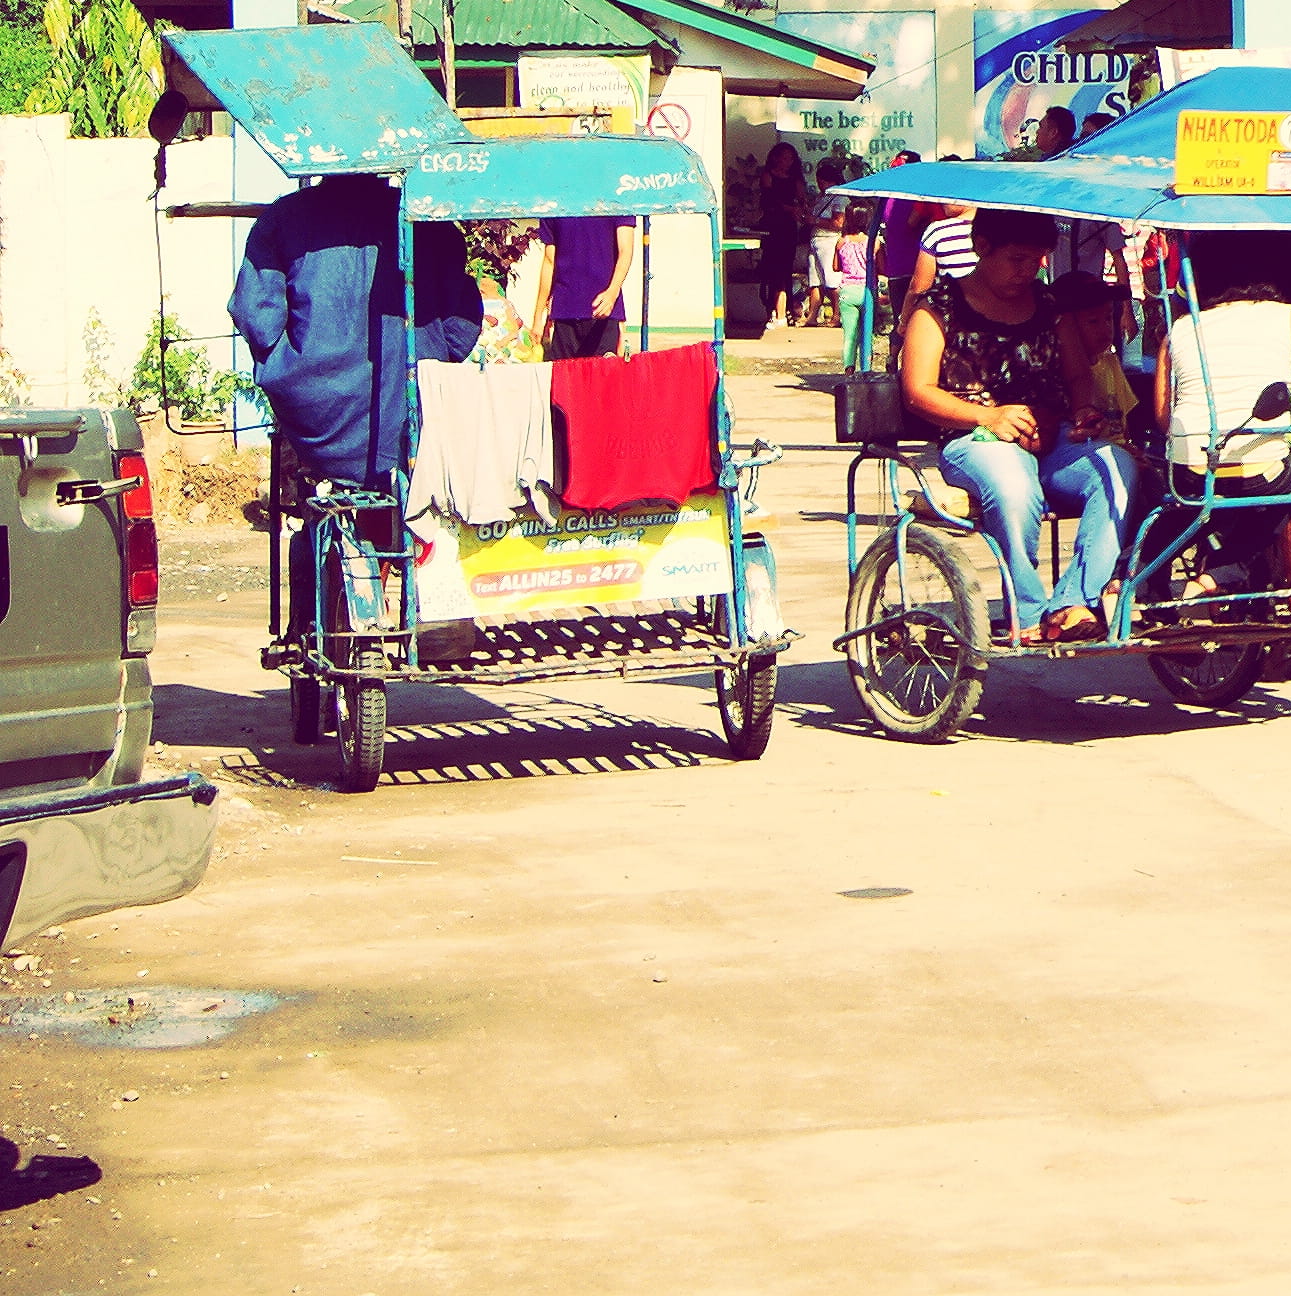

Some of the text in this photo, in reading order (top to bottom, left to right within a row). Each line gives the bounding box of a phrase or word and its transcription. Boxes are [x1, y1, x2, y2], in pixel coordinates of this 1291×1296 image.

[1013, 52, 1129, 84] CHILD
[530, 83, 558, 97] clean
[800, 110, 914, 132] The best gift
[1182, 117, 1278, 144] NHAKTODA
[804, 134, 907, 155] we can give
[477, 521, 508, 541] 60
[566, 513, 618, 533] CALLS
[500, 569, 573, 592] ALLIN25
[590, 562, 637, 583] 2477
[661, 561, 719, 577] SMART
